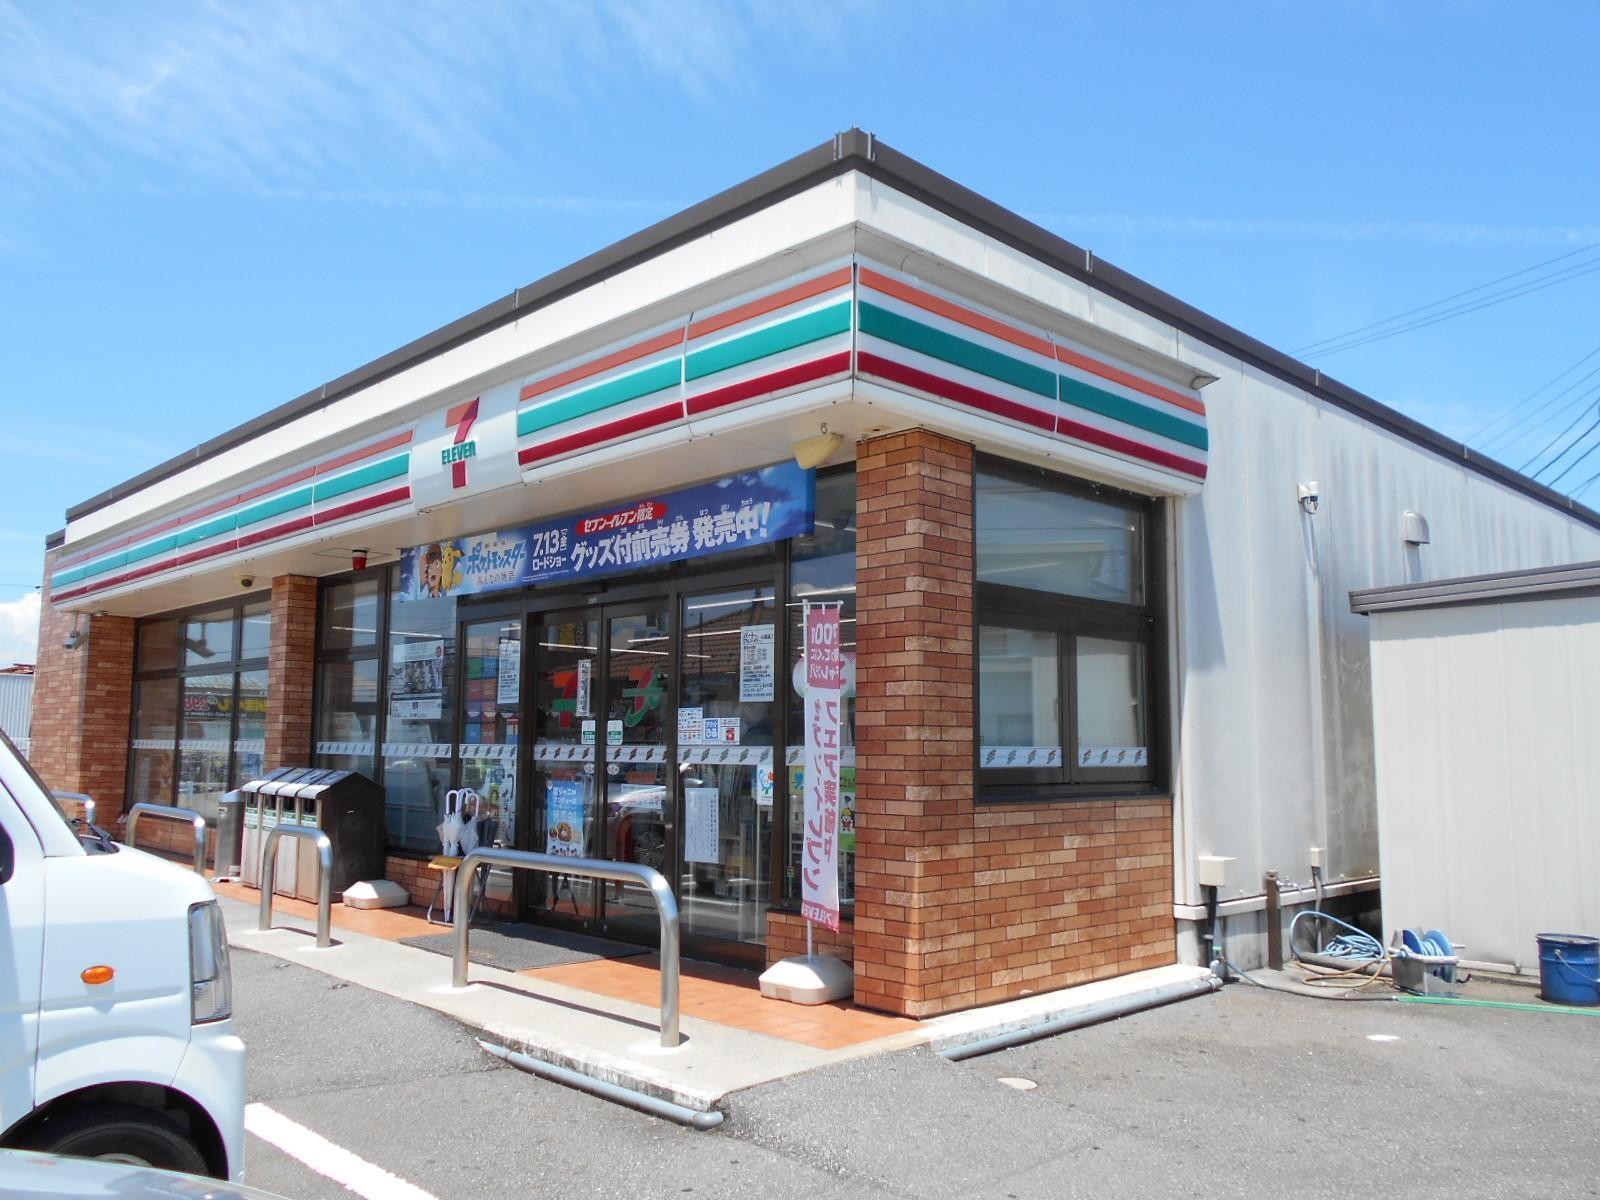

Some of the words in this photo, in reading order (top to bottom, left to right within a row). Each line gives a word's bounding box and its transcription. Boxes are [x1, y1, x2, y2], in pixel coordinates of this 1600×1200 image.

[445, 396, 480, 489] 7
[533, 529, 560, 557] 7.13
[532, 555, 567, 571] ロードショー
